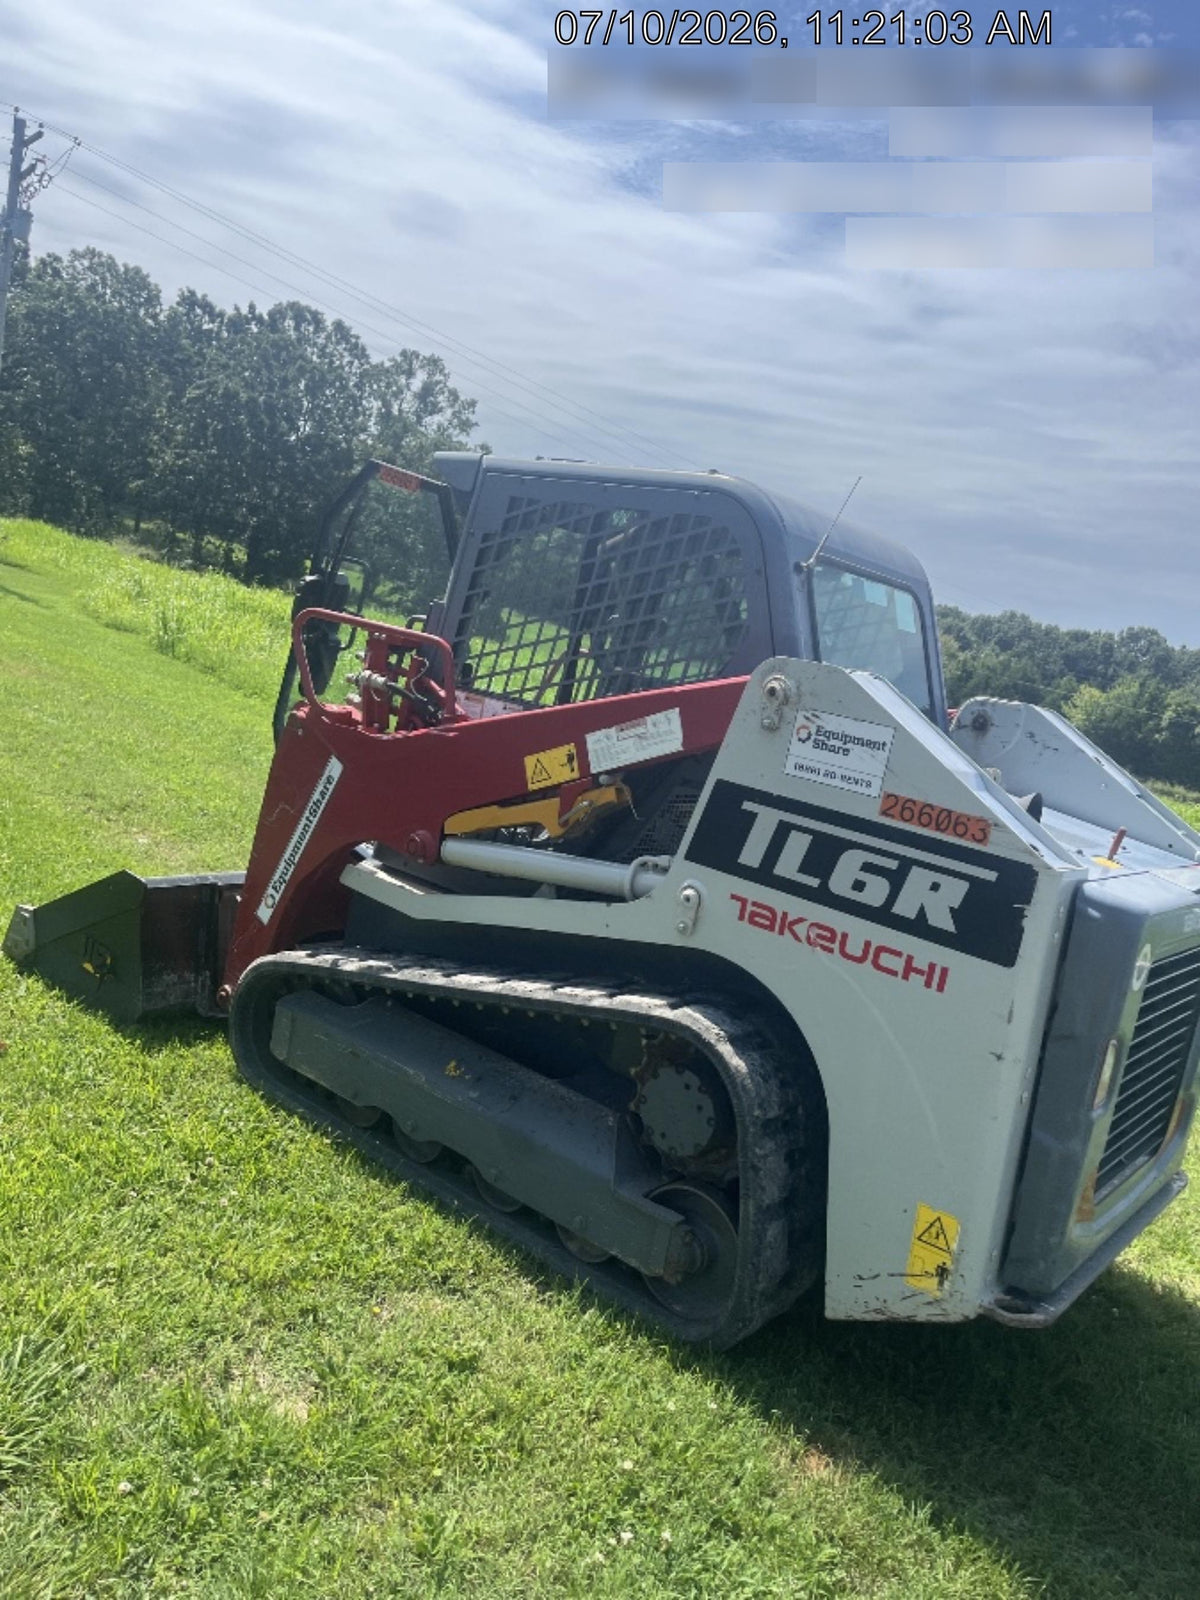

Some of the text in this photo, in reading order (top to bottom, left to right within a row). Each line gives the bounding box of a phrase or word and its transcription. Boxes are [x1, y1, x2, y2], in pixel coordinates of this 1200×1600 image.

[812, 738, 851, 756] Share
[815, 725, 887, 752] Equipment
[271, 774, 335, 894] EquipmentShare
[881, 794, 989, 843] 266063
[737, 800, 998, 934] TL6R
